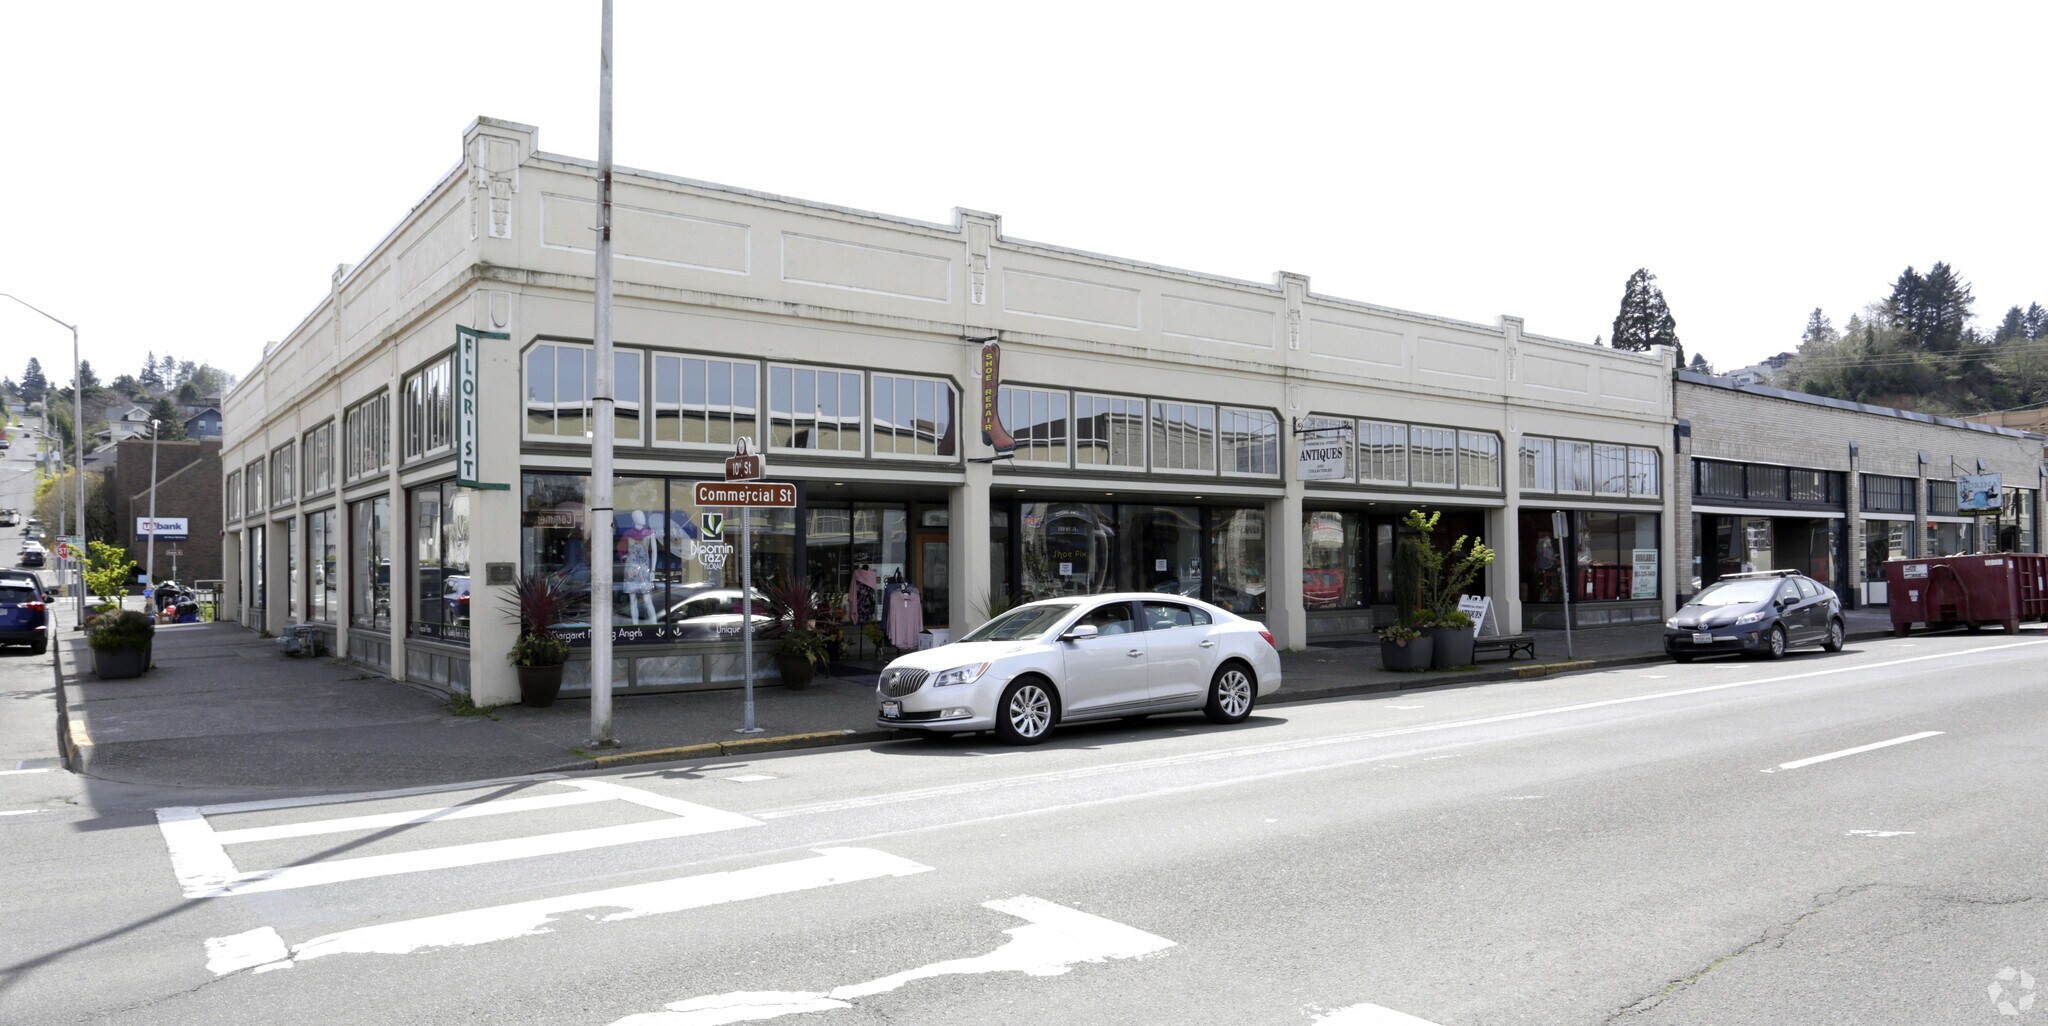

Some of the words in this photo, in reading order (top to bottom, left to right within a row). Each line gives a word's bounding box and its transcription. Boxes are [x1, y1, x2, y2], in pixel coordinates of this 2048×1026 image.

[985, 353, 993, 381] SHOE
[463, 338, 474, 476] FLORIST
[1300, 446, 1343, 462] ANTIQUES
[744, 461, 752, 475] St
[700, 487, 774, 502] Commercial
[780, 488, 792, 502] St
[690, 540, 734, 555] Bloomin
[698, 553, 727, 567] Crazy
[618, 627, 643, 641] Angels
[716, 625, 741, 637] Unique
